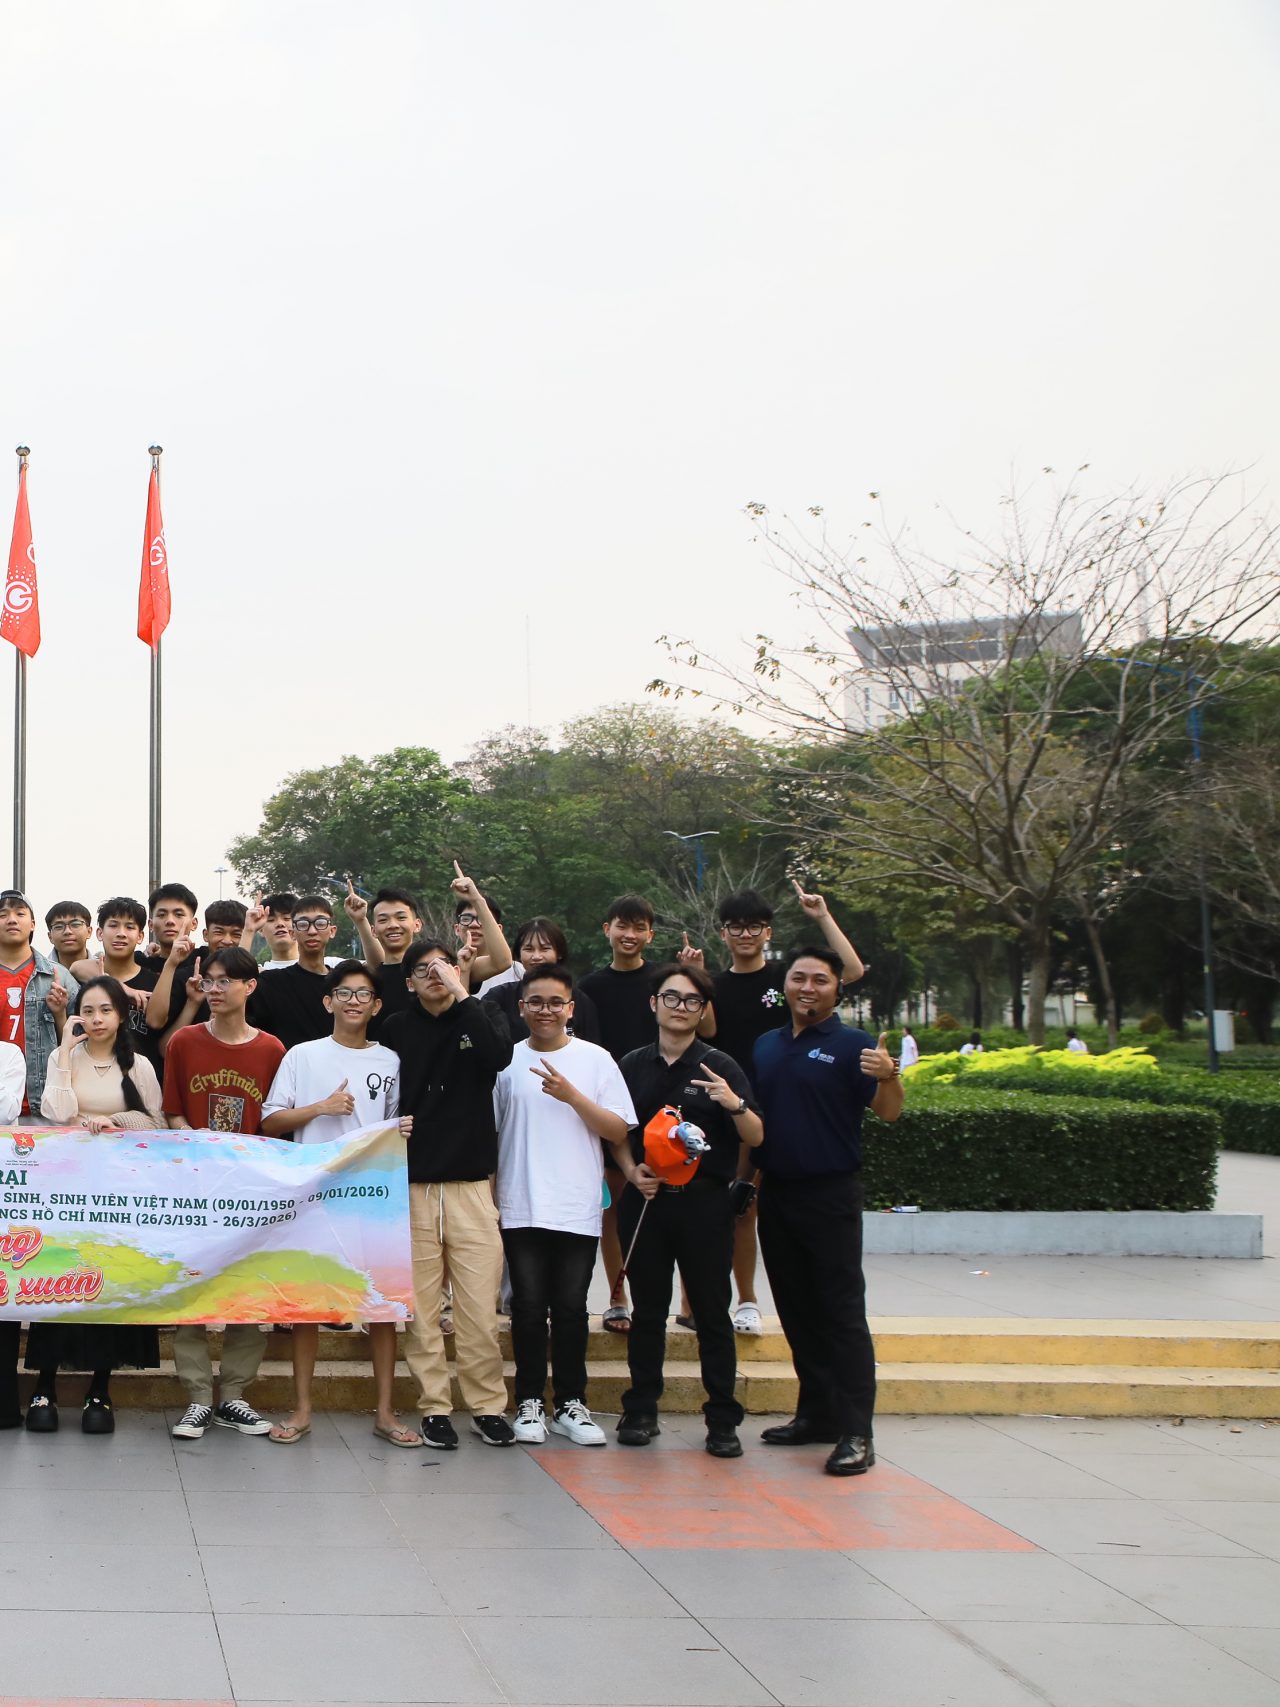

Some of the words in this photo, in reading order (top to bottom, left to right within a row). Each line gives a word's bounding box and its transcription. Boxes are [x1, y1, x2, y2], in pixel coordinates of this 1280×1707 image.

[9, 1014, 21, 1041] 7
[3, 1192, 45, 1206] SINH,
[49, 1193, 87, 1206] SINH
[91, 1193, 128, 1207] VIÊN
[132, 1195, 169, 1211] VIỆT
[173, 1198, 208, 1210] NAM
[212, 1199, 295, 1213] (09/01/1950
[308, 1185, 389, 1203] 09/01/2026)
[32, 1205, 54, 1220] HỒ
[58, 1209, 85, 1222] CHÍ
[89, 1211, 132, 1224] MINH
[136, 1212, 208, 1227] (26/3/1931
[223, 1210, 297, 1228] 26/3/2026)
[15, 1264, 104, 1306] xuân
